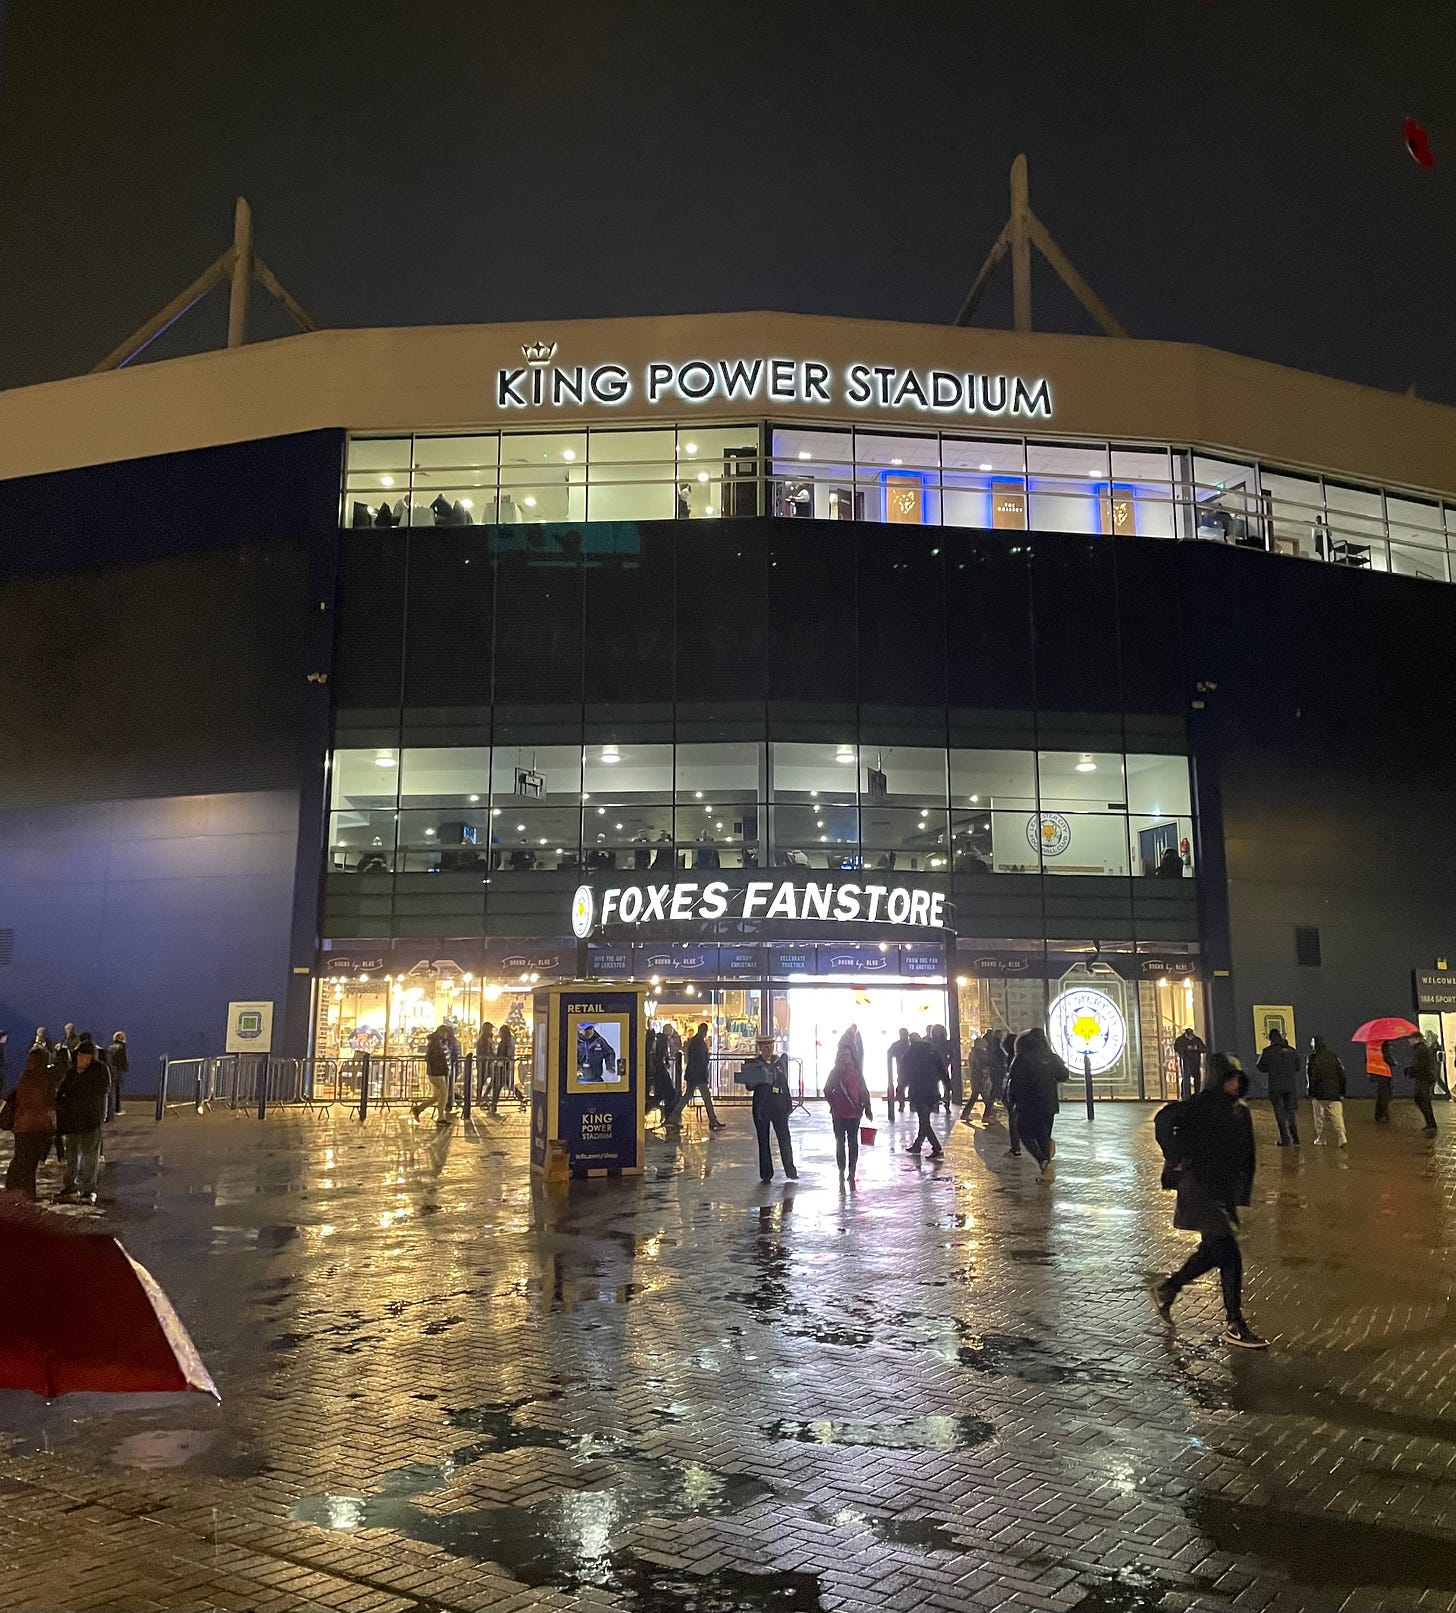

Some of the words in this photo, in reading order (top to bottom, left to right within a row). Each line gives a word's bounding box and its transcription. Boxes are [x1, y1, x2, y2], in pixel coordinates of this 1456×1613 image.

[497, 363, 631, 406] KING
[649, 359, 831, 400] POWER
[847, 364, 1053, 416] STADIUM
[601, 881, 729, 925] FOXES
[741, 882, 945, 928] FANSTORE
[567, 1004, 605, 1013] RETAIL
[582, 1113, 613, 1124] KING
[582, 1124, 612, 1132] POWER
